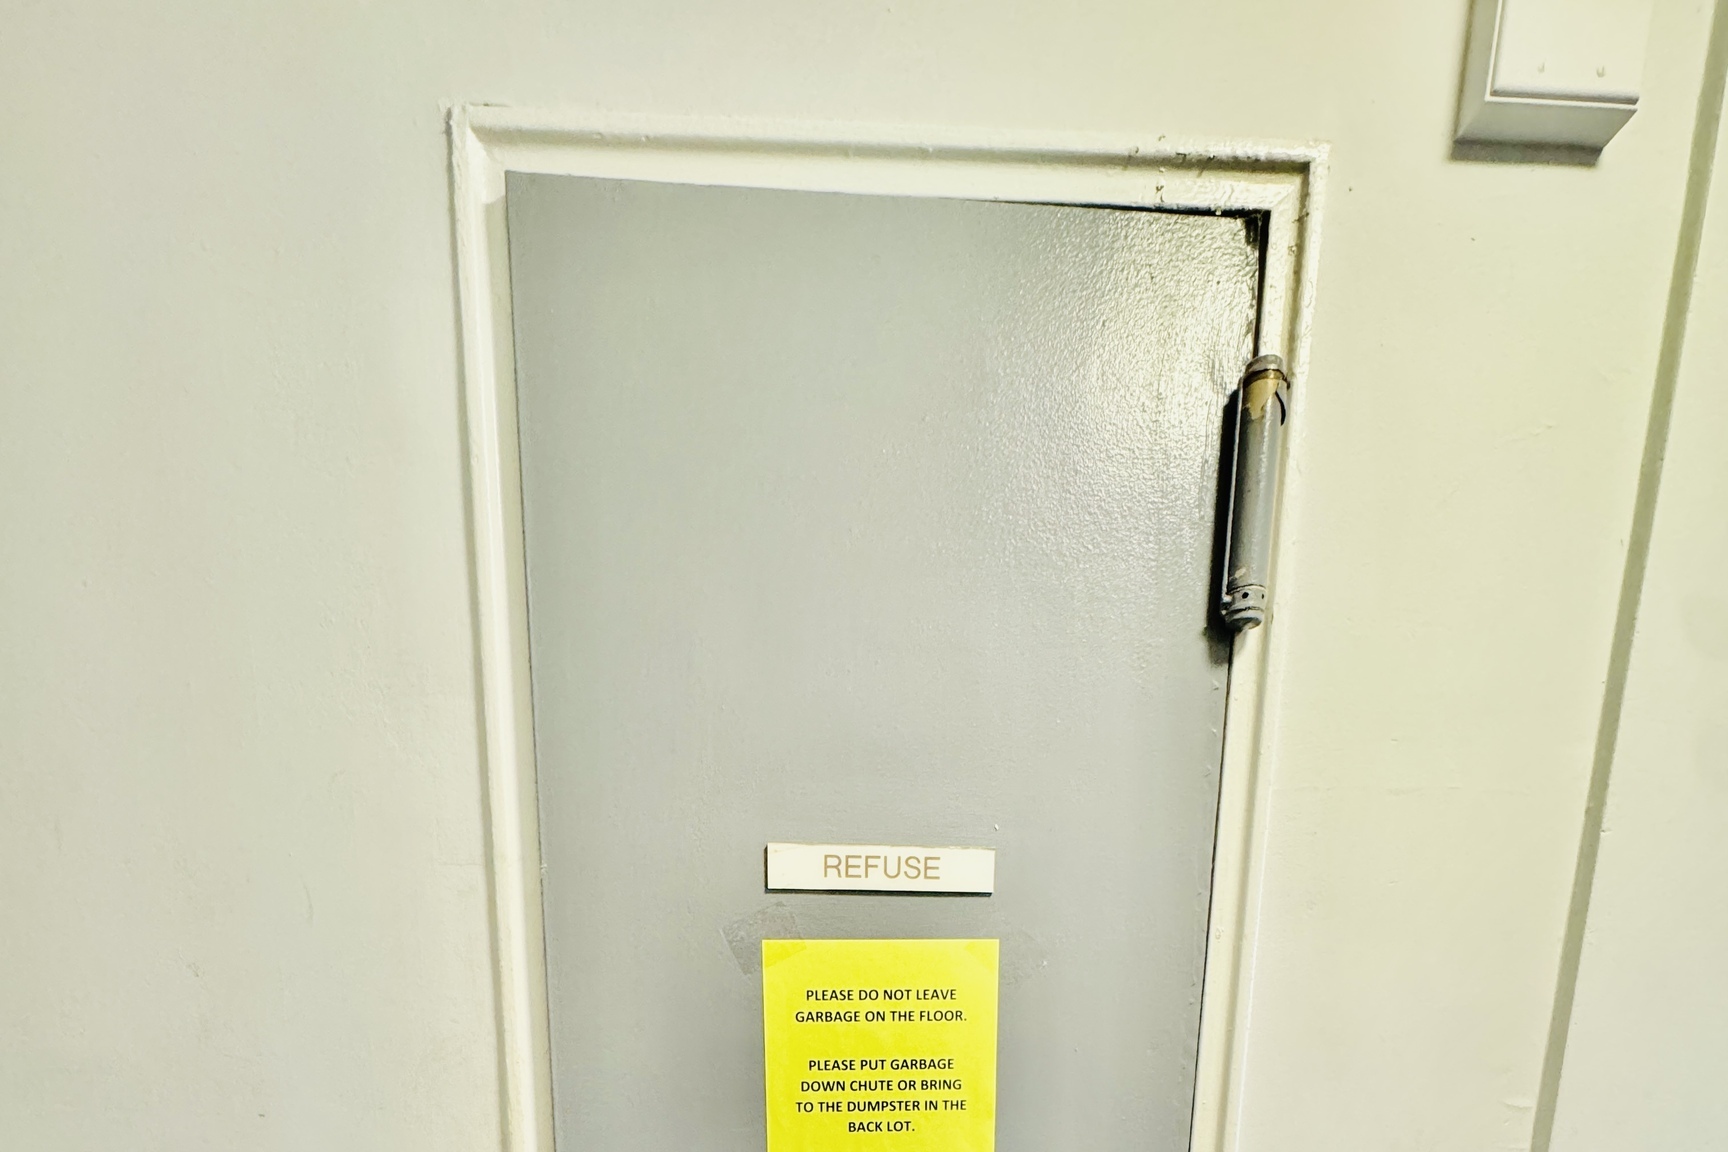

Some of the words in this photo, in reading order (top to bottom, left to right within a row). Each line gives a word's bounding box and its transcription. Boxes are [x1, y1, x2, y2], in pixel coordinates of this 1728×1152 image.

[823, 854, 941, 880] REFUSE
[806, 989, 854, 1001] PLEASE
[858, 989, 879, 1001] DO
[883, 989, 912, 1001] NOT
[916, 989, 956, 1001] LEAVE
[795, 1010, 860, 1023] GARBAGE
[864, 1010, 886, 1022] ON
[889, 1010, 915, 1022] THE
[919, 1010, 967, 1022] FLOOR.
[808, 1059, 856, 1071] PLEASE
[860, 1059, 887, 1071] PUT
[890, 1058, 954, 1071] GARBAGE
[800, 1080, 846, 1092] DOWN
[849, 1079, 894, 1092] CHUTE
[897, 1079, 917, 1091] OR
[920, 1079, 962, 1091] BRING
[795, 1101, 814, 1113] TO
[817, 1101, 843, 1113] THE
[847, 1100, 921, 1112] DUMPSTER
[924, 1100, 938, 1111] IN
[942, 1099, 966, 1111] THE
[848, 1121, 883, 1133] BACK
[887, 1120, 915, 1132] LOT.
